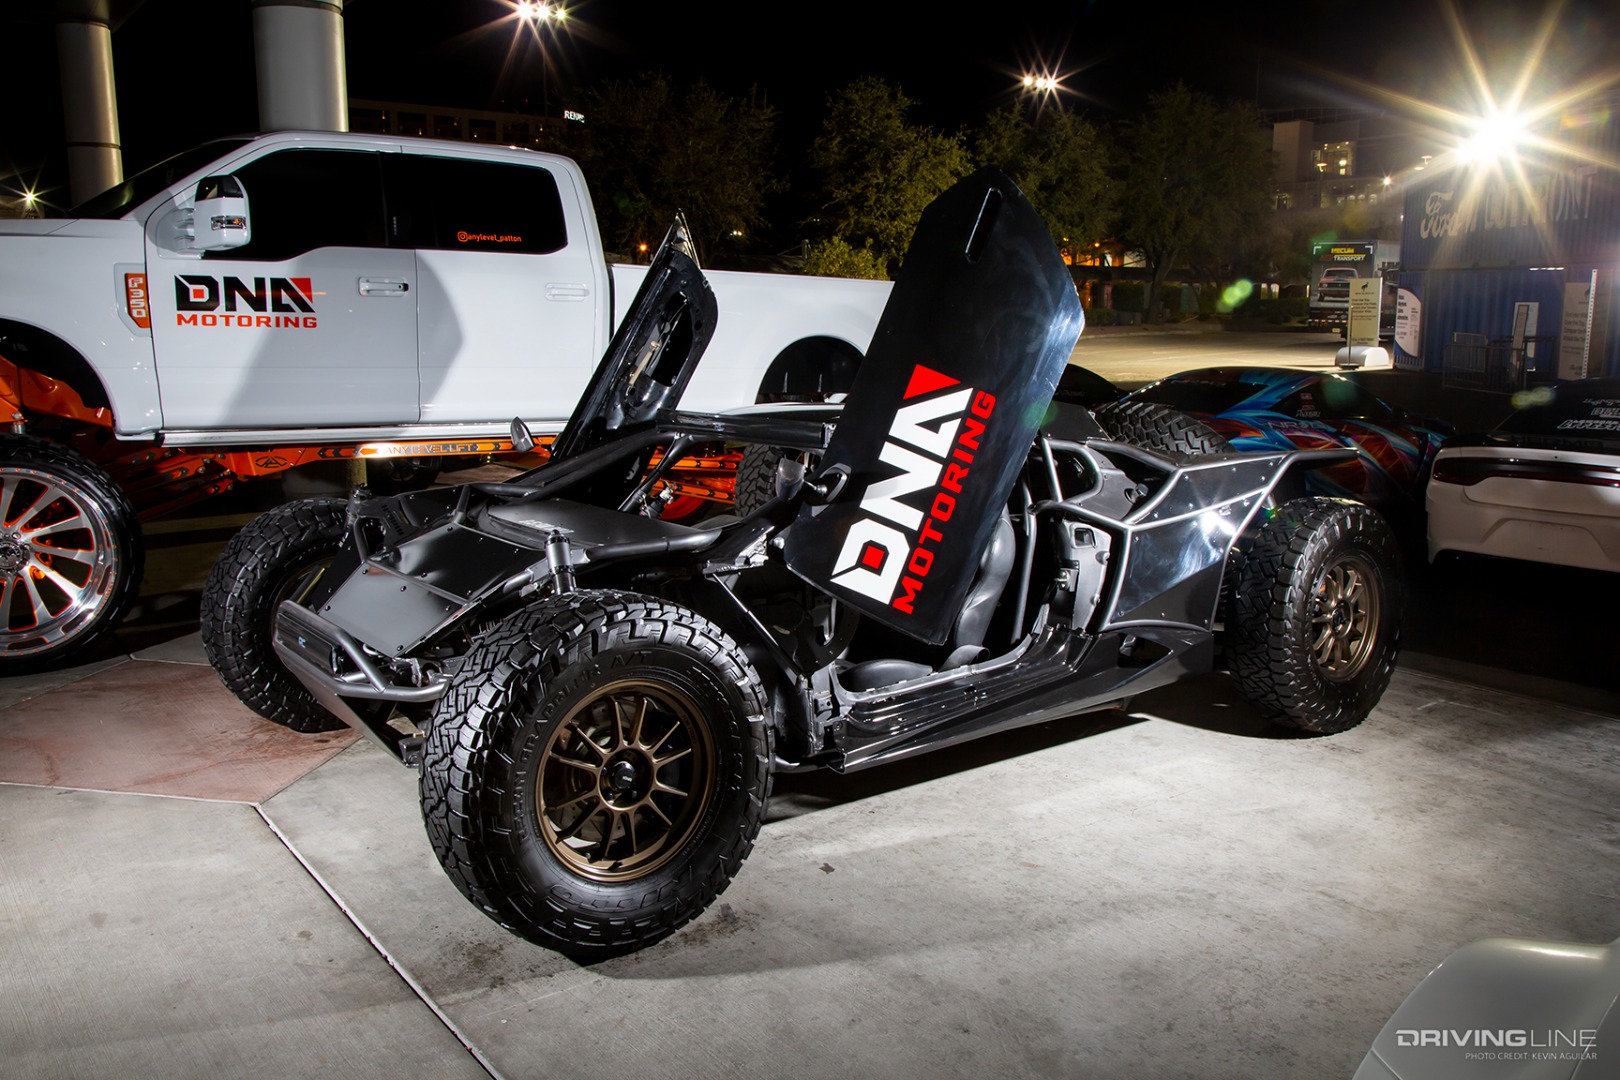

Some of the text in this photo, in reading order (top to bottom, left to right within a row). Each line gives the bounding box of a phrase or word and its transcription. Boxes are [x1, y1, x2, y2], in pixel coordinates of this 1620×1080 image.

[467, 233, 522, 243] anylevel_patton
[127, 276, 147, 318] F350
[174, 274, 316, 313] DNA
[176, 314, 318, 329] MOTORING
[449, 443, 473, 453] LIFT
[830, 364, 974, 605] DNA
[892, 390, 997, 615] MOTORING
